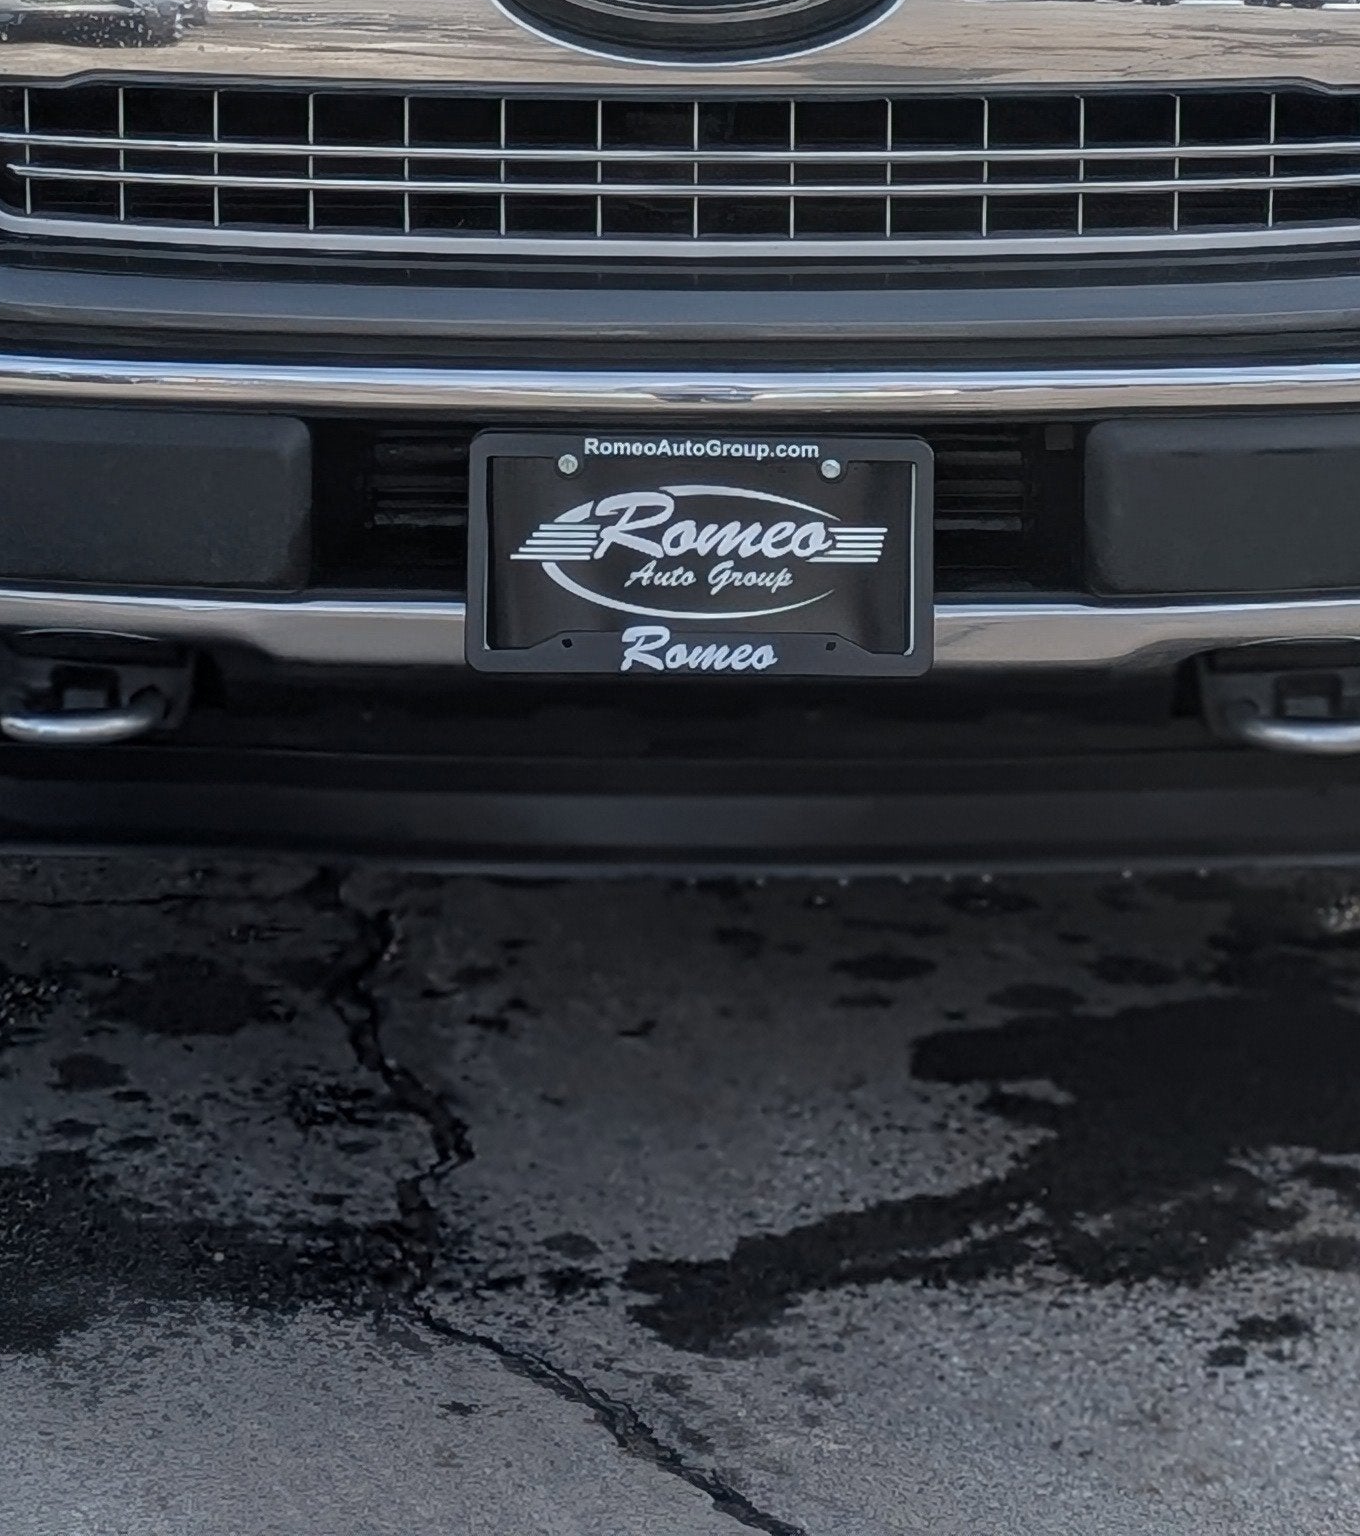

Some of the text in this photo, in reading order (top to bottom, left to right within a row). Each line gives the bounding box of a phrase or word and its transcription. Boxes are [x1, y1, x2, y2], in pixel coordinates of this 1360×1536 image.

[584, 437, 820, 461] RomeoAutoGroup.com
[594, 490, 834, 560] Romeo
[624, 560, 794, 596] Auto Group
[620, 624, 779, 672] Romeo
